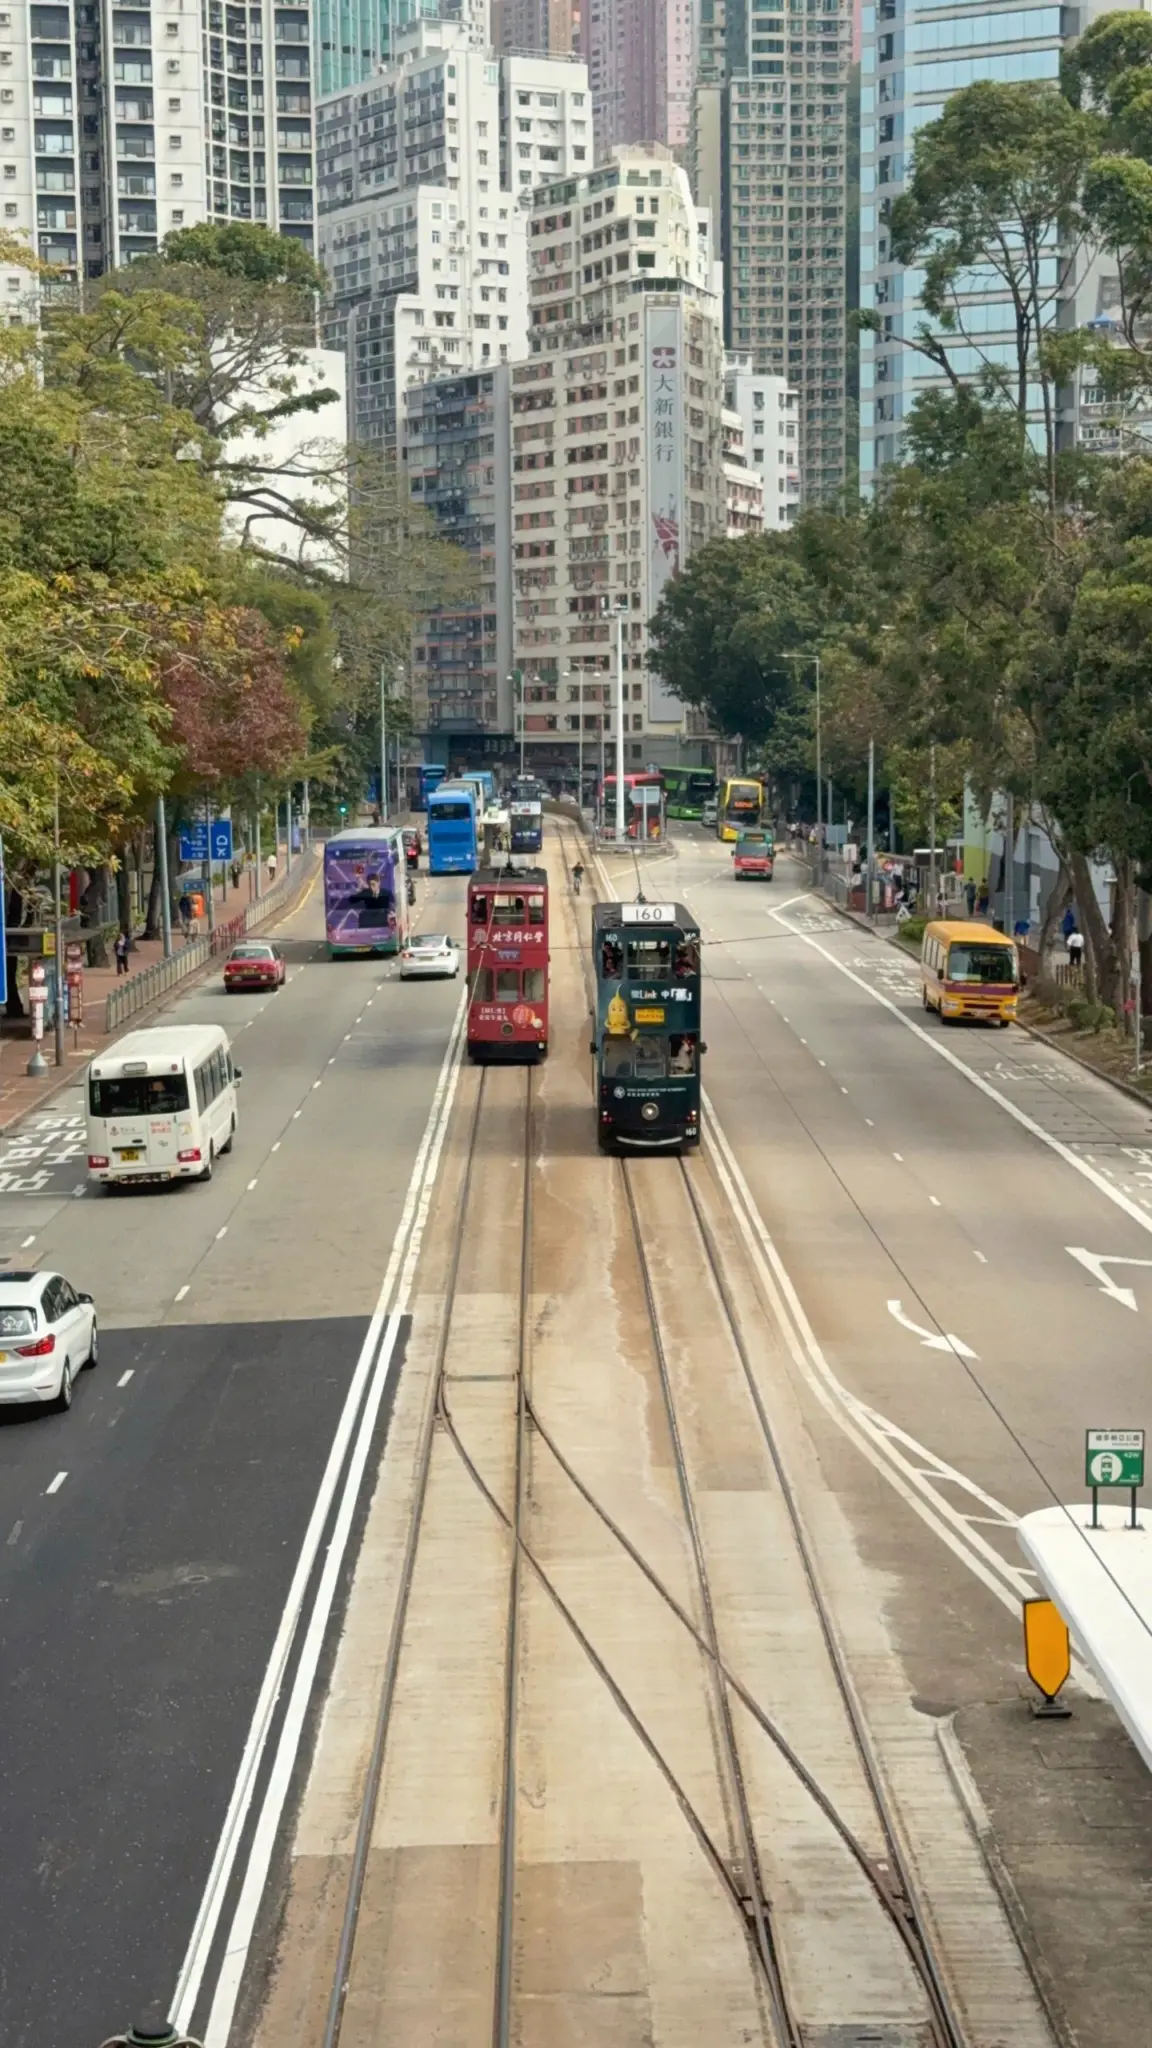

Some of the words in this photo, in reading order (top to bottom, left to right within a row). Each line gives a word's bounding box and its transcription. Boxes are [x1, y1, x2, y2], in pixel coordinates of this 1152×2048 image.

[654, 374, 674, 462] 大新銀行
[635, 907, 663, 921] 160
[605, 932, 618, 942] 160
[36, 1116, 87, 1130] BU
[8, 1130, 87, 1145] STO
